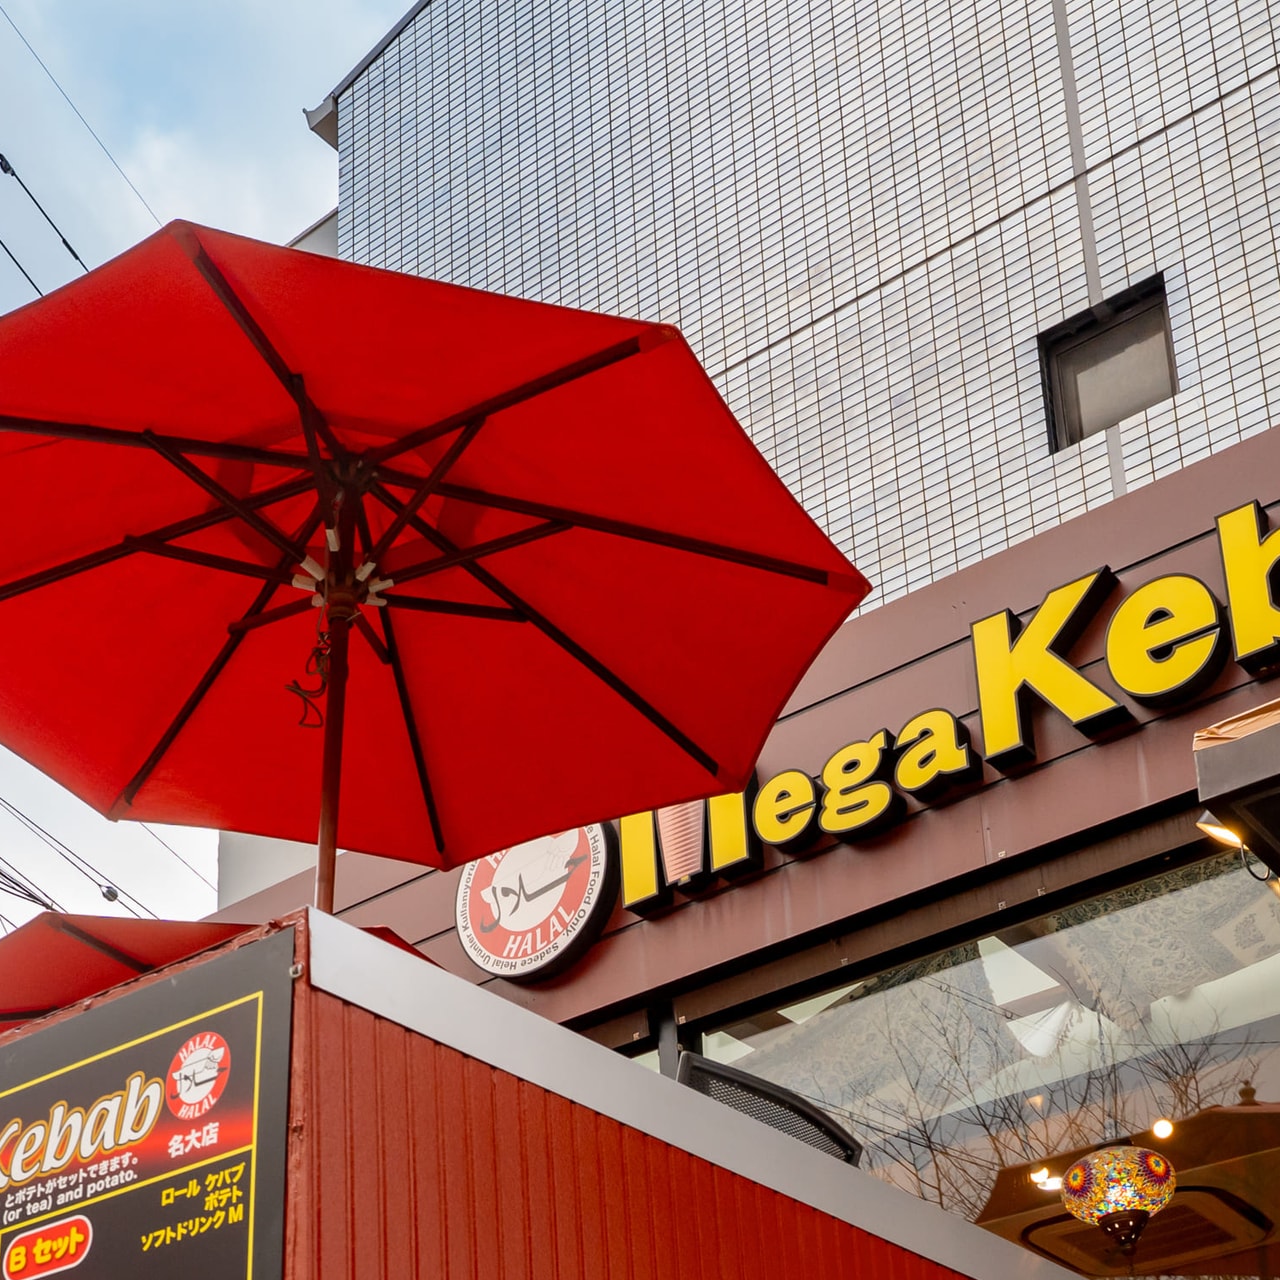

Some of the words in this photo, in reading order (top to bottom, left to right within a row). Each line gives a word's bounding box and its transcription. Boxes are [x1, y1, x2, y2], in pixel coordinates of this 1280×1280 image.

[584, 871, 600, 905] Food
[503, 908, 575, 957] HALAL
[562, 909, 587, 937] Only.
[493, 958, 517, 971] Helal
[521, 942, 559, 967] Sadece
[179, 1034, 217, 1063] HALAL
[178, 1094, 217, 1119] HALAL
[168, 1122, 219, 1158] 名大店
[3, 1204, 23, 1225] (or
[25, 1195, 53, 1216] tea)
[56, 1188, 84, 1205] and
[86, 1170, 138, 1198] potato.
[161, 1179, 201, 1207] ロール
[204, 1162, 246, 1191] ケバブ
[141, 1211, 226, 1251] ソフトドリンク
[228, 1203, 244, 1224] M
[9, 1245, 26, 1273] B
[33, 1226, 85, 1265] セット
